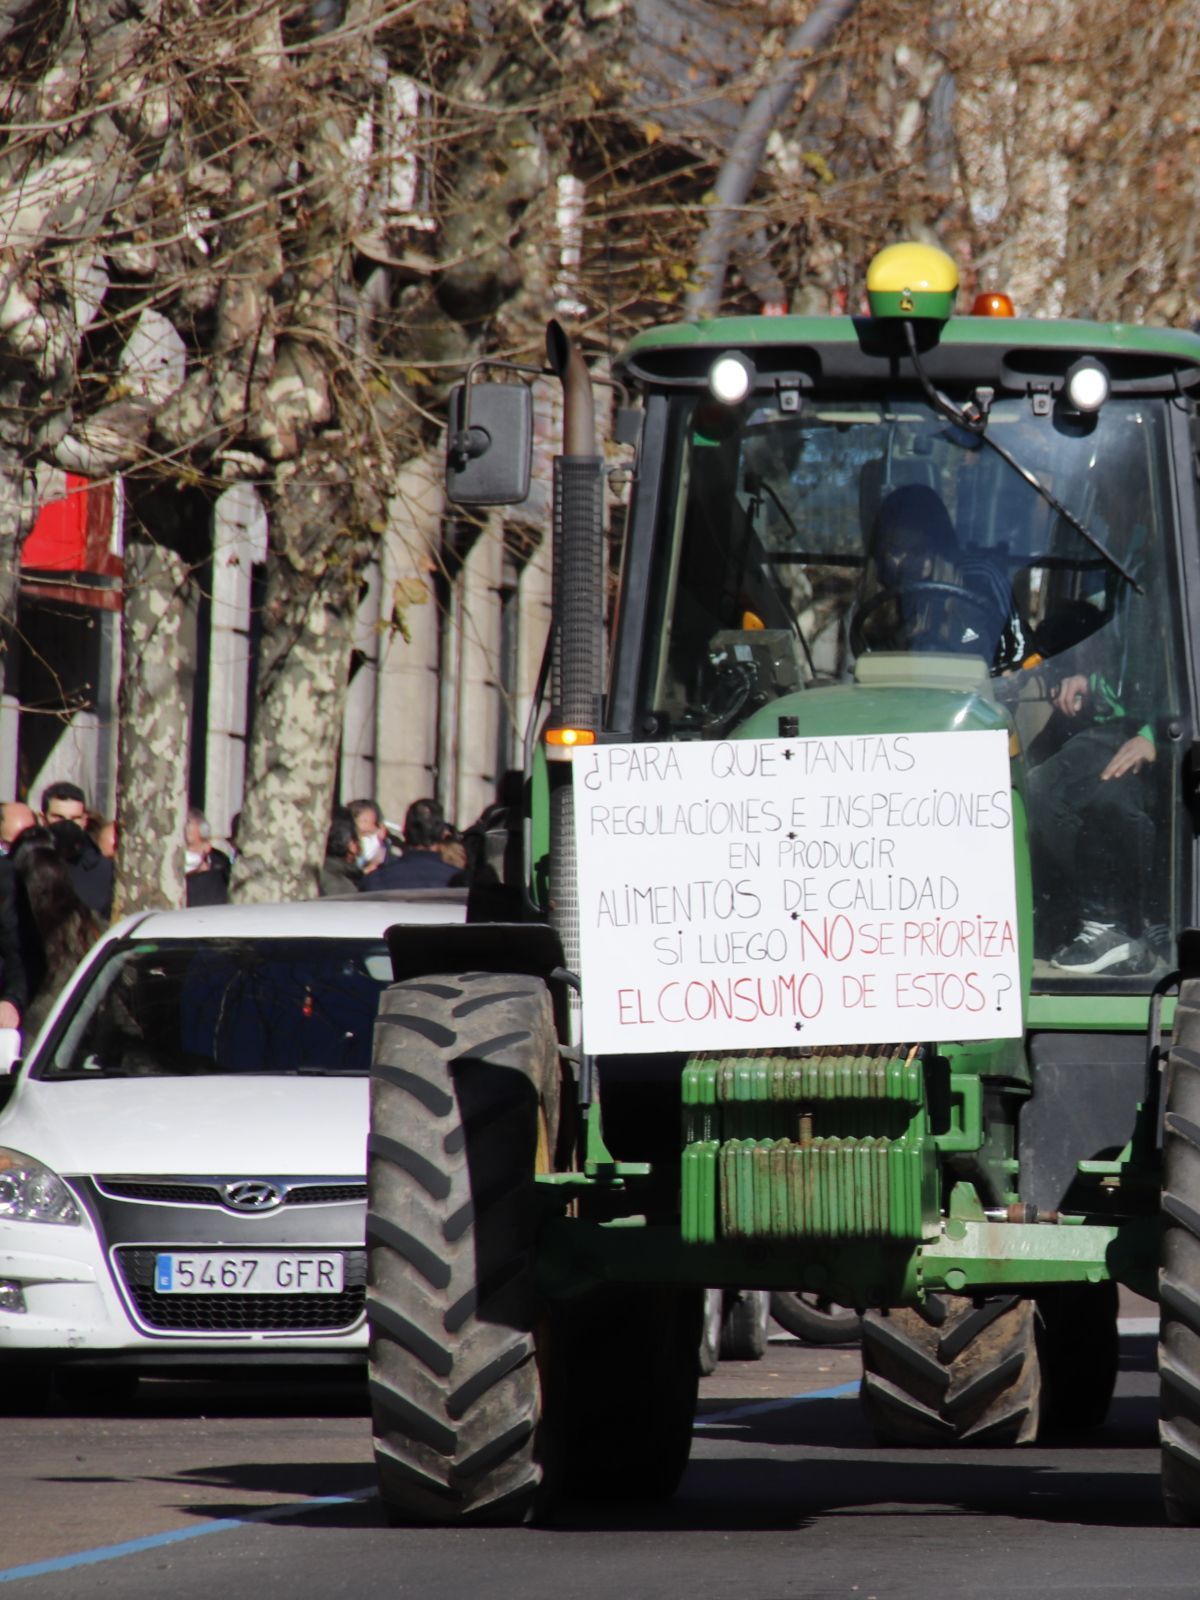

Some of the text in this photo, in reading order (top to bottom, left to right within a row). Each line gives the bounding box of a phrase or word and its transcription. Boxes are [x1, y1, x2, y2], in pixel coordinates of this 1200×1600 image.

[584, 736, 916, 790] ¿PARA QUE TANTAS
[792, 797, 806, 828] E
[729, 842, 761, 869] EN
[783, 877, 819, 912] DE
[699, 929, 787, 964] LUEGO
[800, 914, 854, 962] NO
[859, 922, 896, 955] SE
[618, 972, 1012, 1025] EL CONSUMO DE ESTOS?
[176, 1259, 258, 1288] 5467
[276, 1259, 335, 1287] GFR
